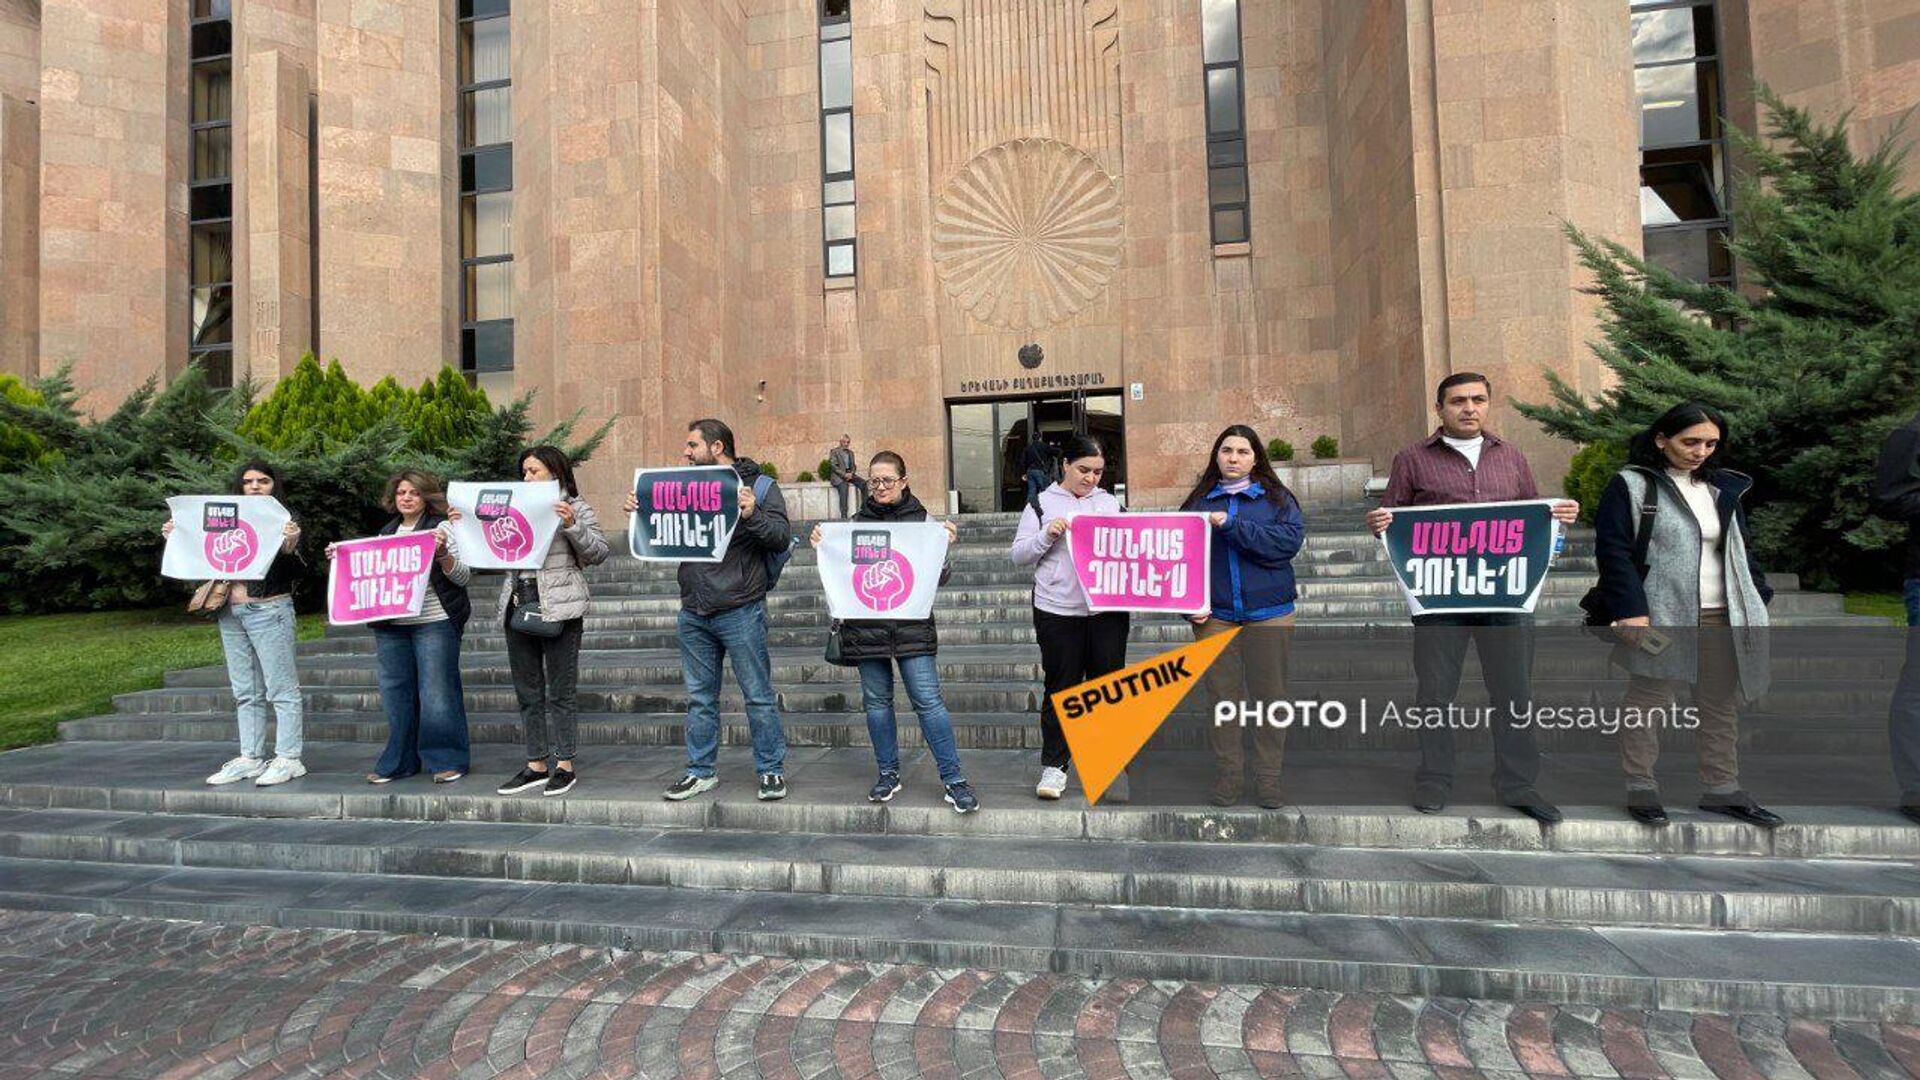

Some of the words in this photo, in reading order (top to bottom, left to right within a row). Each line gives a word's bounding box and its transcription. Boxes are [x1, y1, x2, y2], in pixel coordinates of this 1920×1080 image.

[652, 481, 722, 511] ՄԱՆԴԱՏ
[1093, 526, 1184, 560] ՄԱՆԴԱՏ
[1411, 519, 1525, 555] ՄԱՆԴԱՏ
[350, 544, 422, 578] ՄԱՆԴԱՏ
